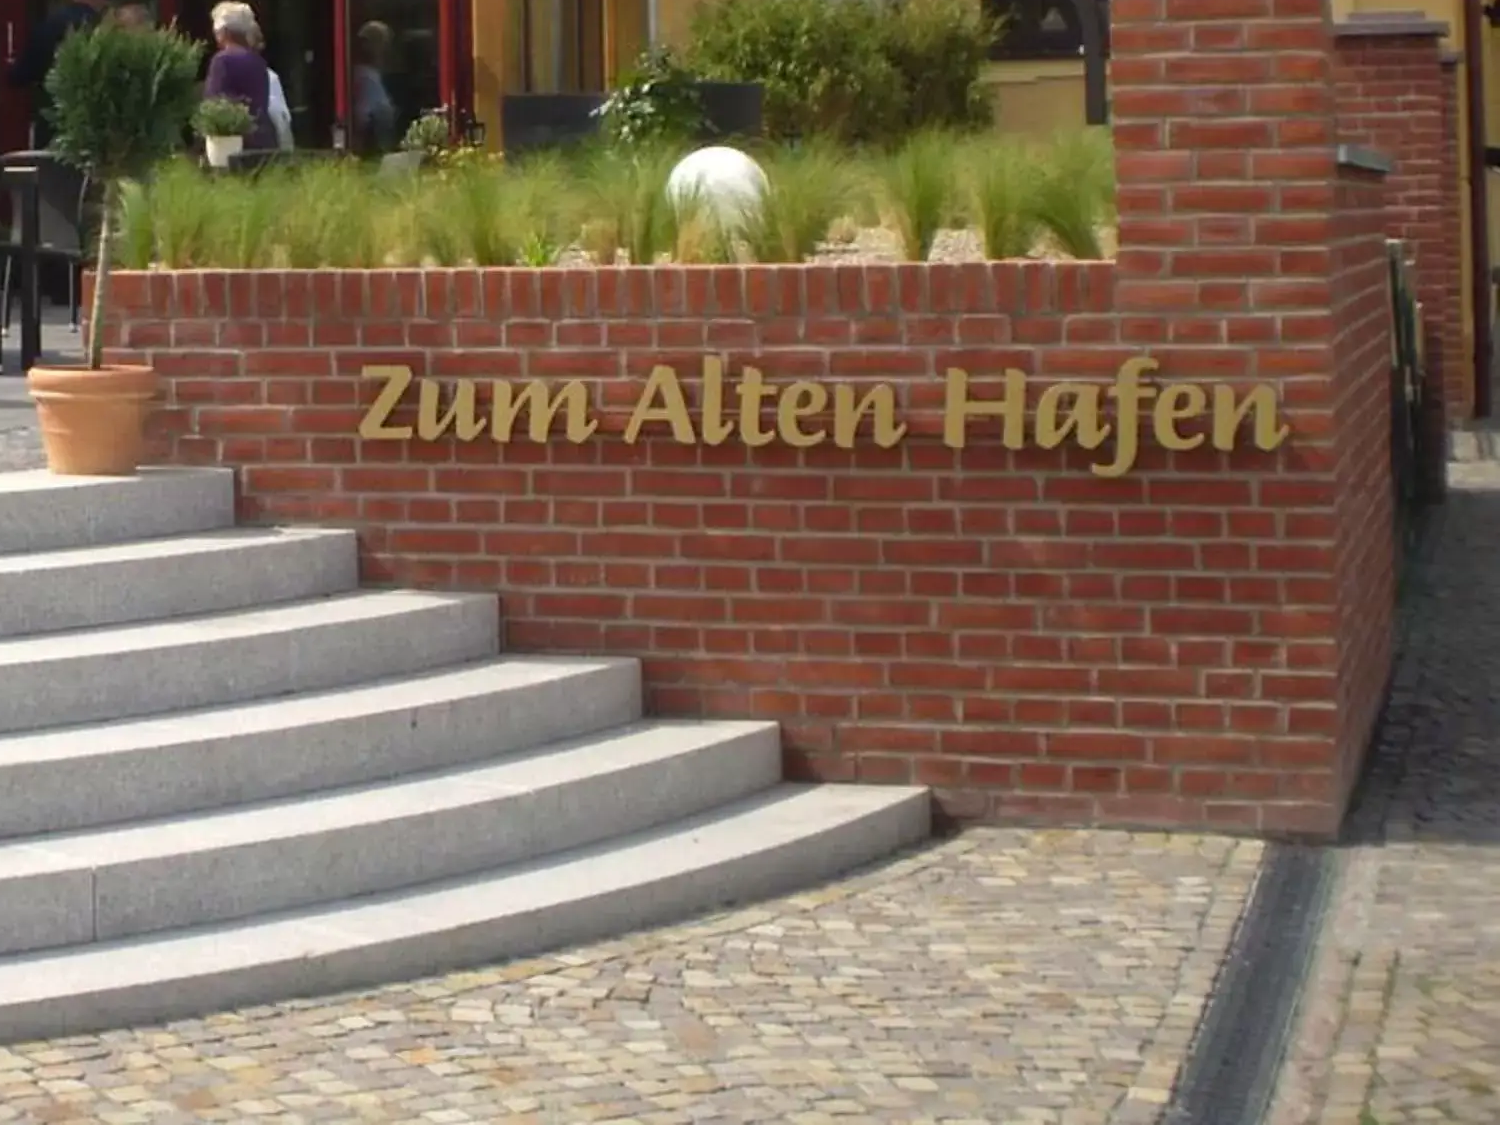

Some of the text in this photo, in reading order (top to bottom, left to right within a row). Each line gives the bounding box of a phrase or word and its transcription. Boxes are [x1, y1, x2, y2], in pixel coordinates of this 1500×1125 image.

[356, 355, 1290, 477] Zum Alten Hafen
